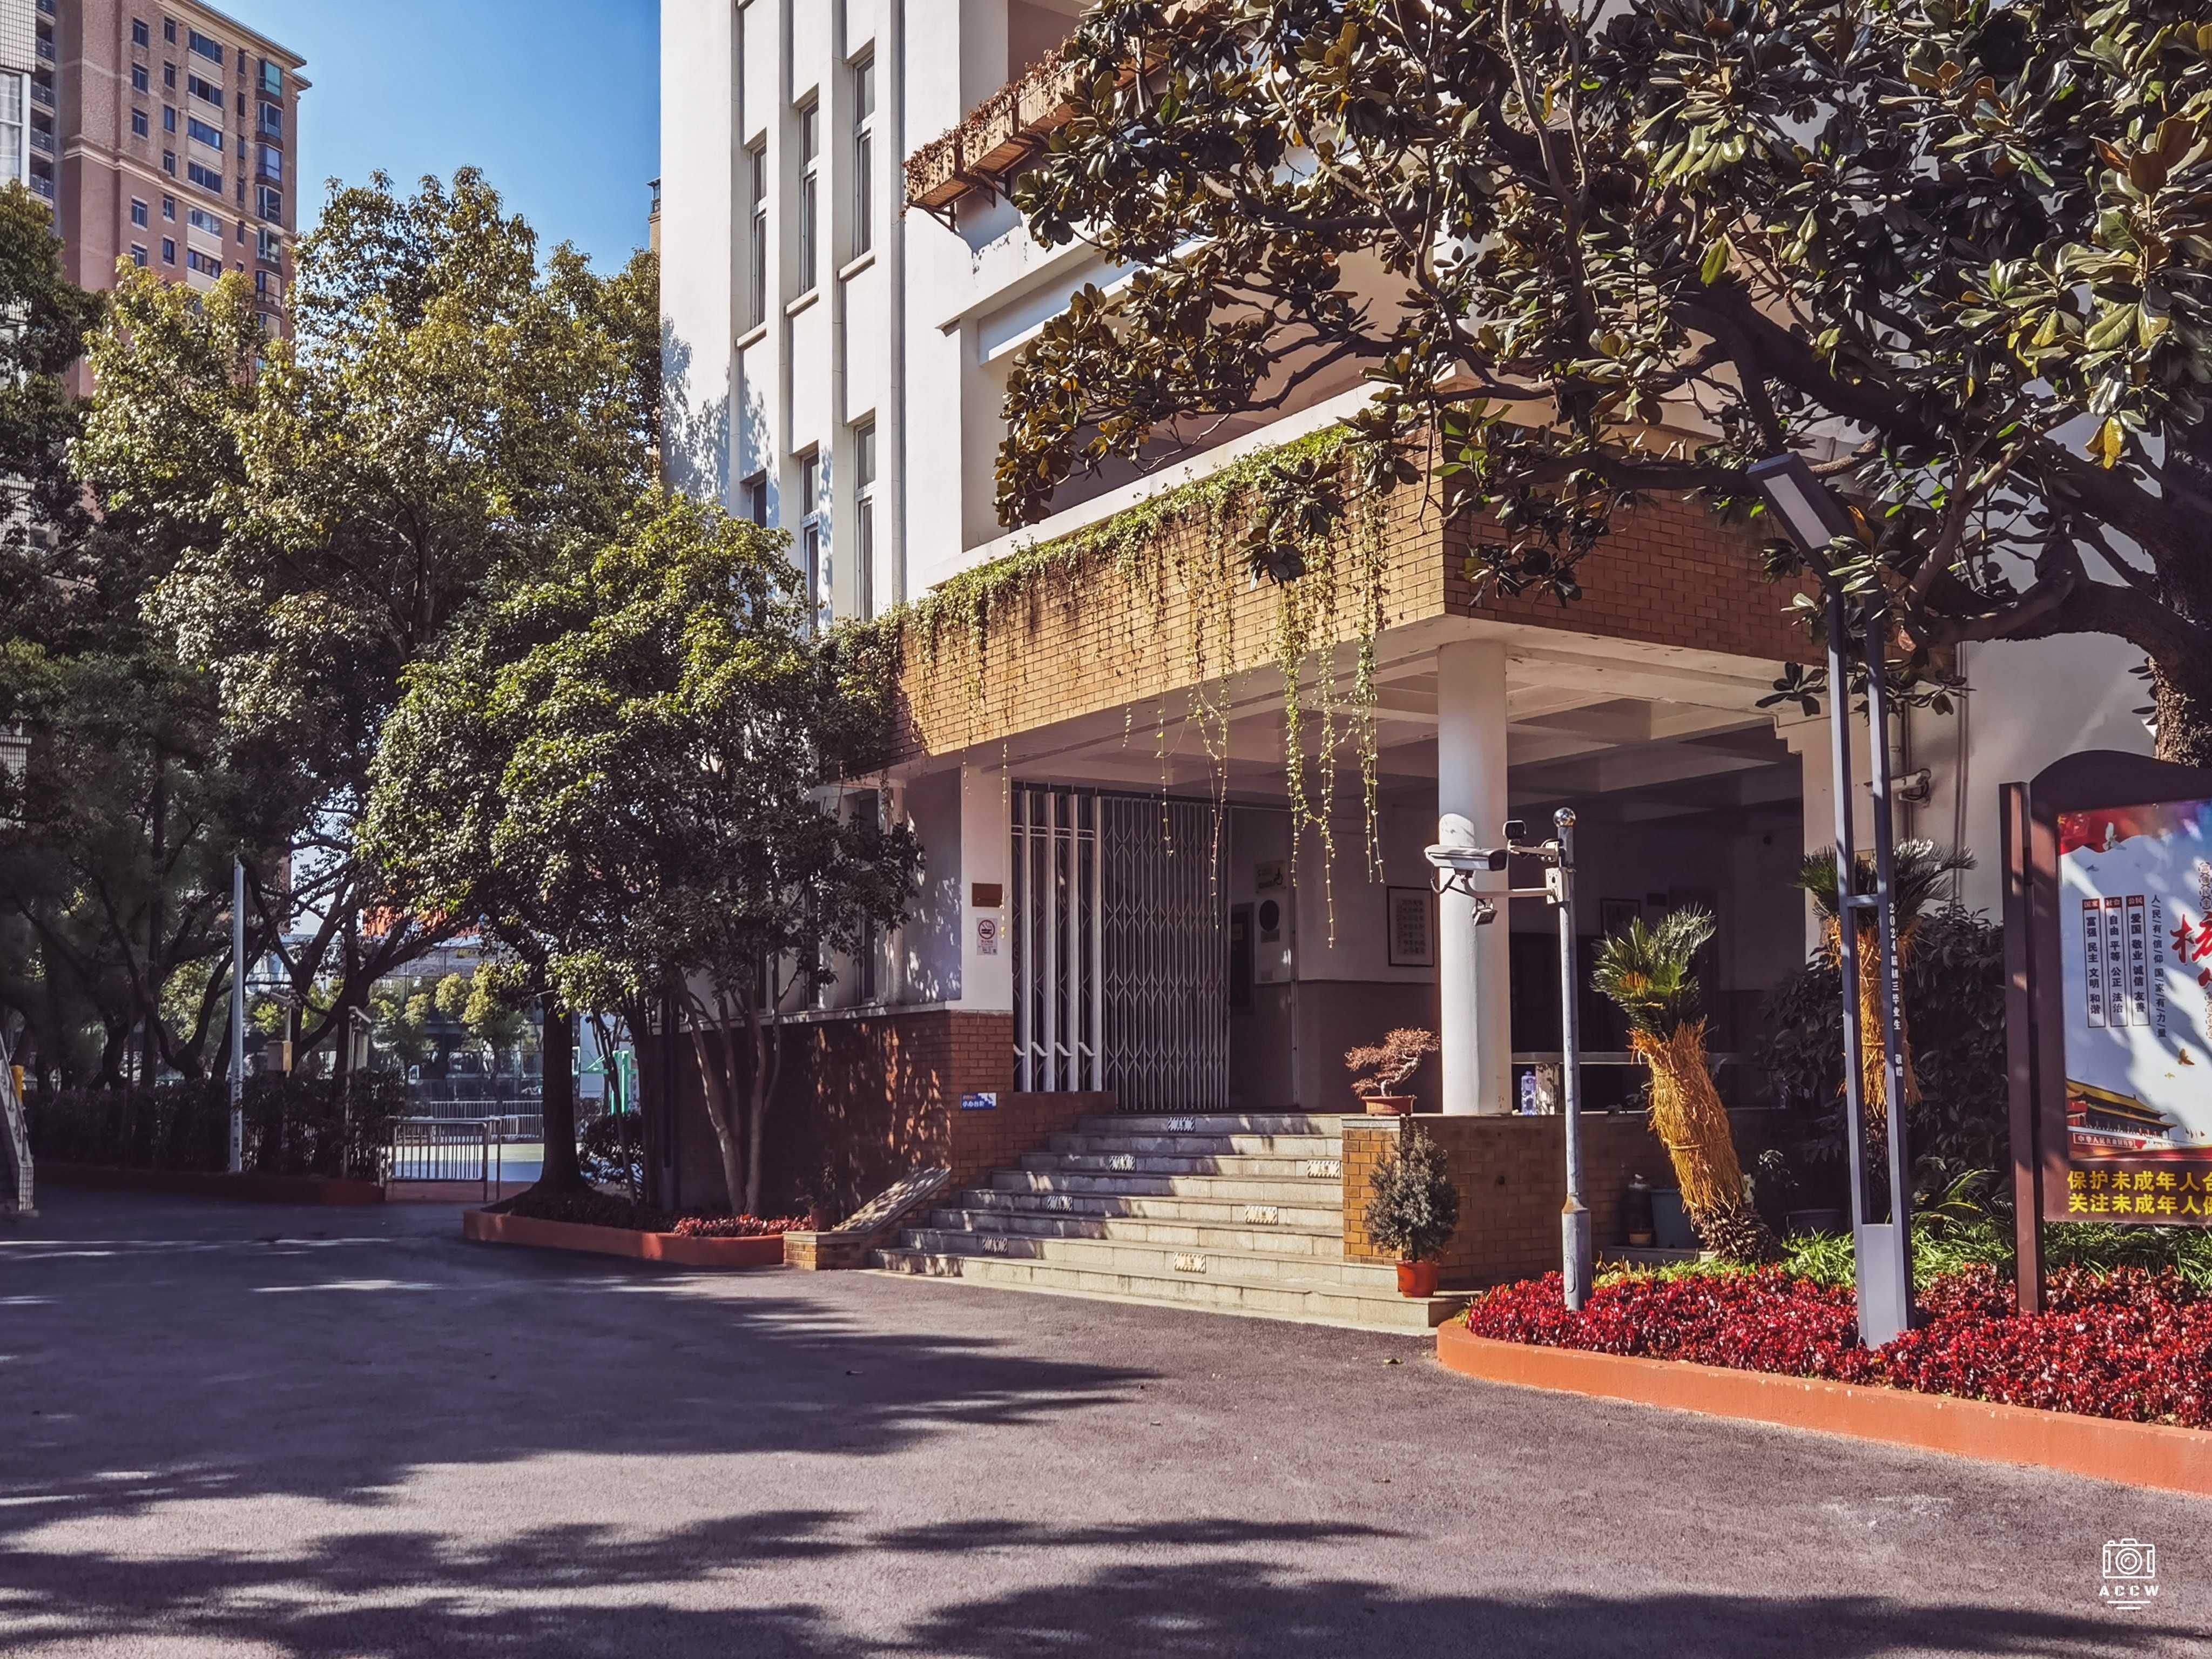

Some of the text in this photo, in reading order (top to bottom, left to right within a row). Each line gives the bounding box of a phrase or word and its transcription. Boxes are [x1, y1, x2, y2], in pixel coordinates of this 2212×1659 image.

[2086, 916, 2100, 1014] 富强 民主 文明 和谐
[2109, 915, 2123, 1013] 自由 平等 公正 法治
[2130, 913, 2145, 1012] 爱国 敬业 诚信 友善
